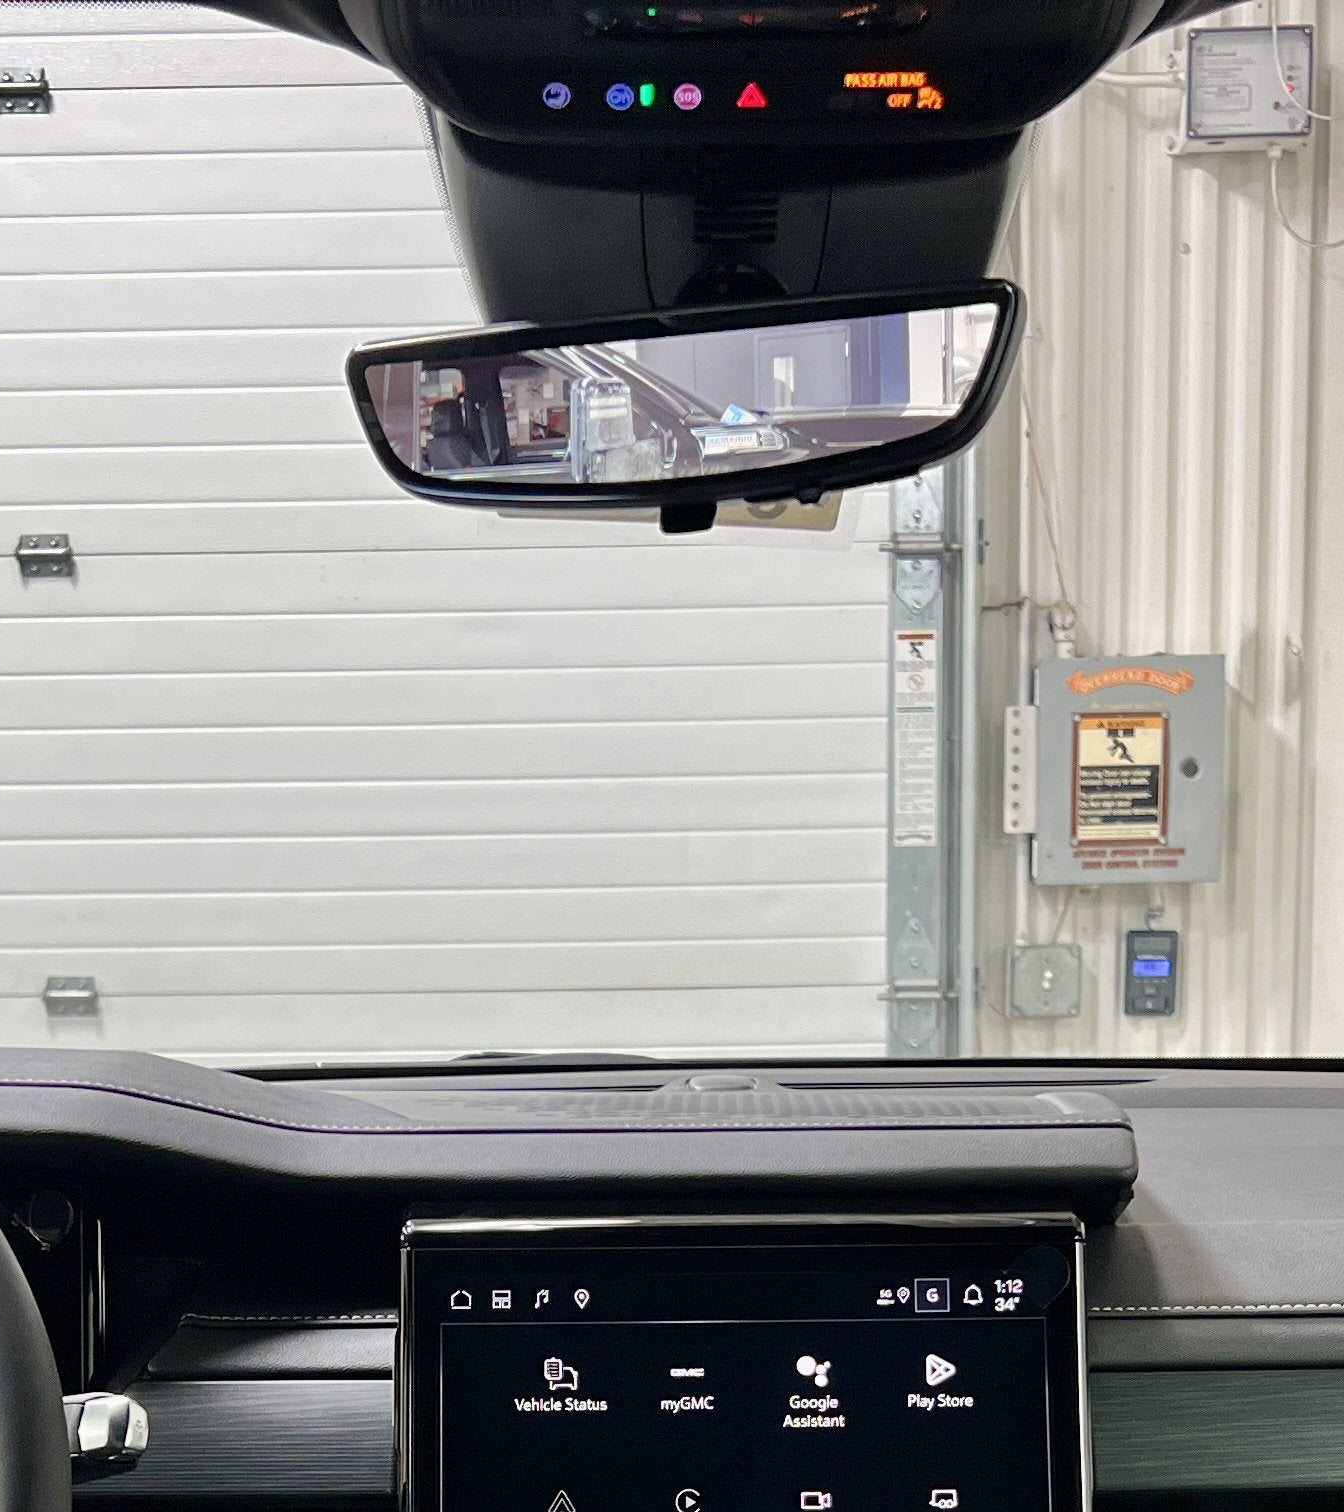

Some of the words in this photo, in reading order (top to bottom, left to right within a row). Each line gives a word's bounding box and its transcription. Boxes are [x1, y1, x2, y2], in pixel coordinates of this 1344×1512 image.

[844, 73, 876, 87] PASS
[878, 73, 898, 87] AIR
[900, 72, 926, 87] BAG
[887, 93, 913, 108] OFF
[994, 1279, 1024, 1294] 1:12
[926, 1288, 939, 1302] G
[994, 1296, 1020, 1312] 34°
[514, 1398, 562, 1412] Vehicle
[565, 1398, 608, 1412] Status
[660, 1396, 715, 1413] myGMC
[789, 1395, 839, 1412] Google
[907, 1393, 935, 1411] Play
[937, 1393, 974, 1408] Store
[782, 1414, 846, 1428] Assistant
